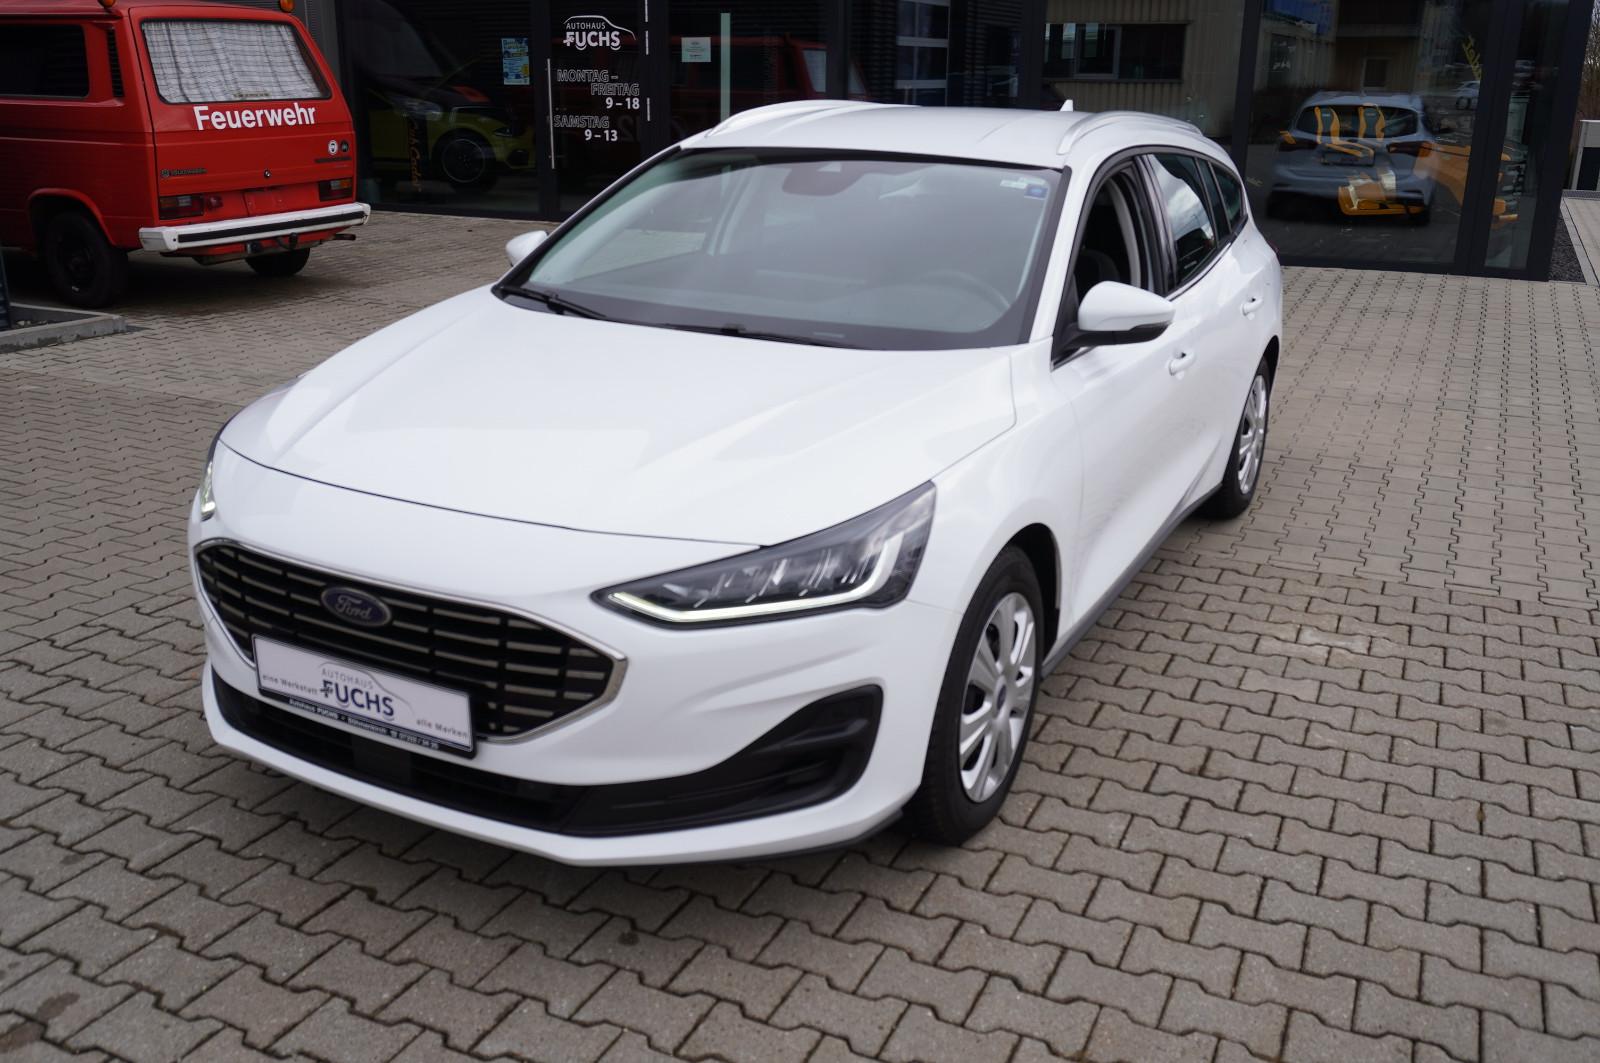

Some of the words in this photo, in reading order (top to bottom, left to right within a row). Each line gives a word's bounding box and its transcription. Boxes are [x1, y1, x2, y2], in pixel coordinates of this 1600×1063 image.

[566, 22, 606, 30] AUTOHAUS
[563, 31, 621, 48] FUCHS
[557, 69, 609, 82] MONTAG
[591, 83, 640, 96] FREITAG
[193, 102, 316, 130] Feuerwehr
[554, 115, 610, 128] SAMSTAG
[335, 595, 372, 620] Ford
[322, 668, 374, 689] AUTOHAUS
[320, 680, 394, 717] FUCHS
